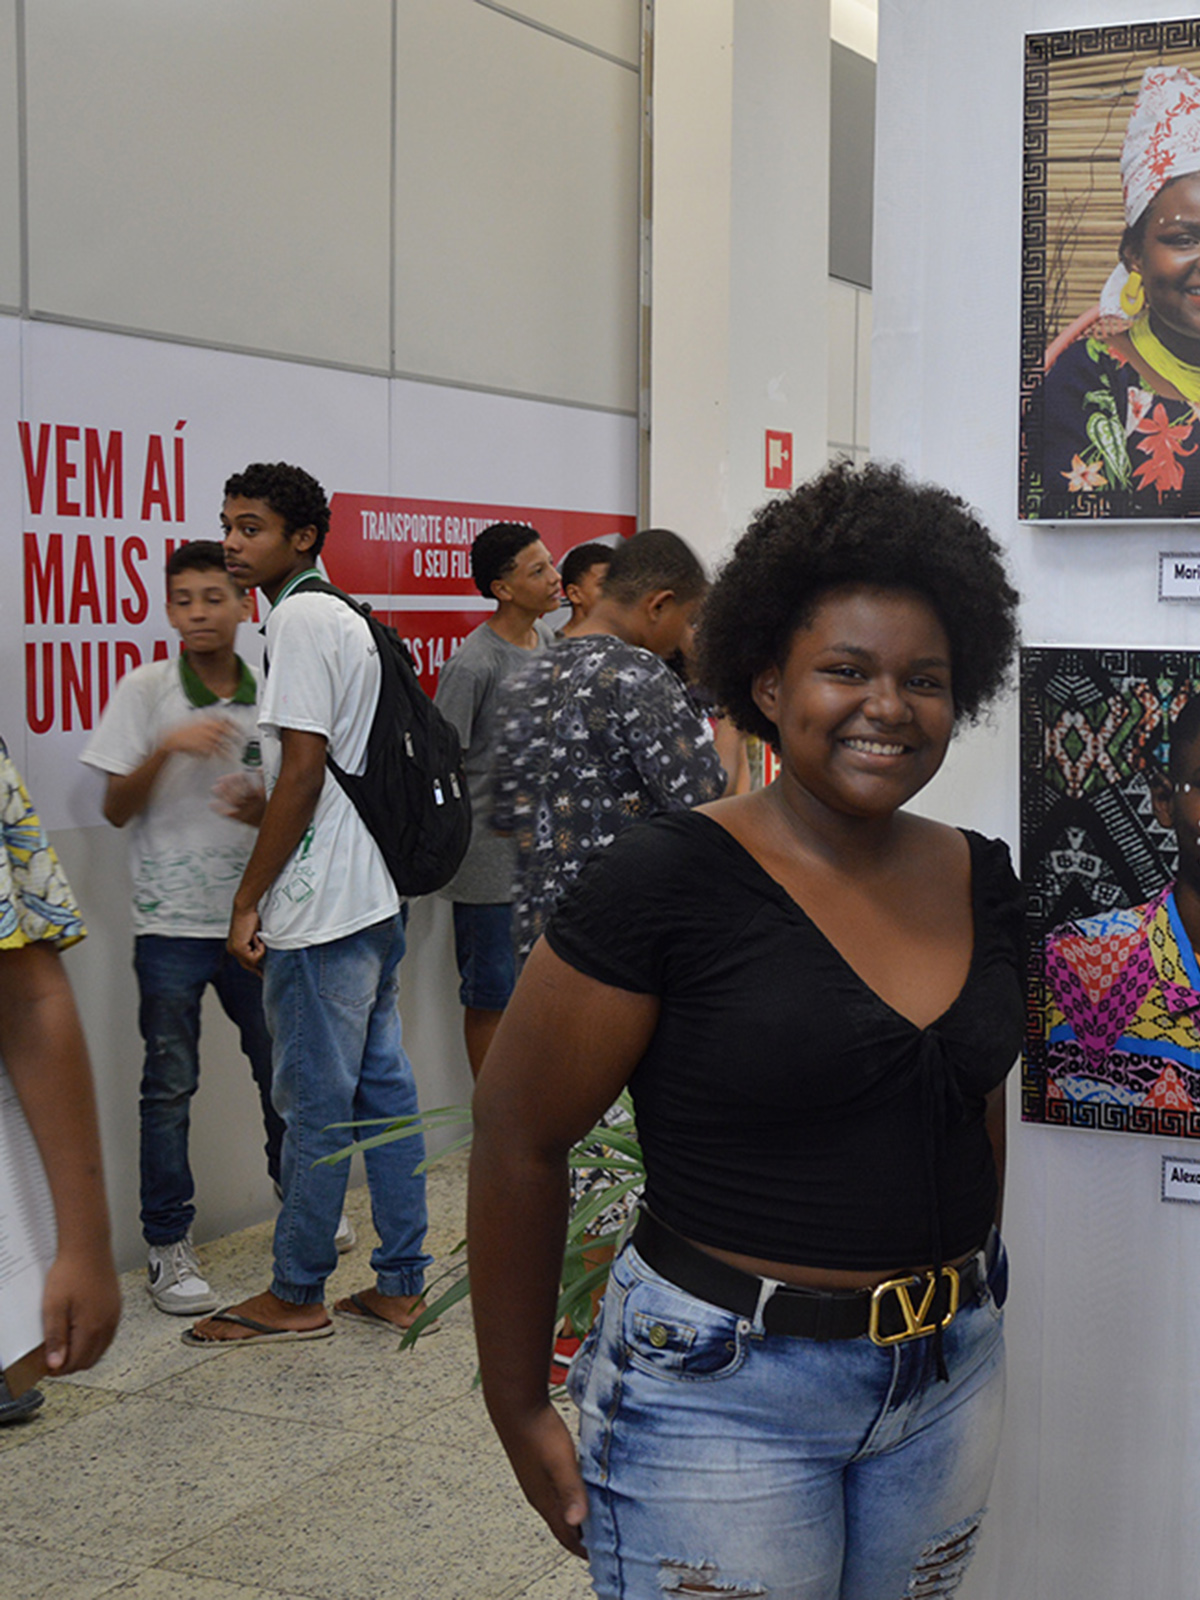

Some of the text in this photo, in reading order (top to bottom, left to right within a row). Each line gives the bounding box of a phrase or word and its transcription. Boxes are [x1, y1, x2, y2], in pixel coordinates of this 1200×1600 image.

[18, 419, 187, 522] VEM AÍ
[361, 510, 500, 545] TRANSPORTE GRATU
[23, 532, 148, 625] MAIS
[413, 549, 422, 578] O
[425, 549, 448, 578] SEU
[426, 637, 445, 675] 14
